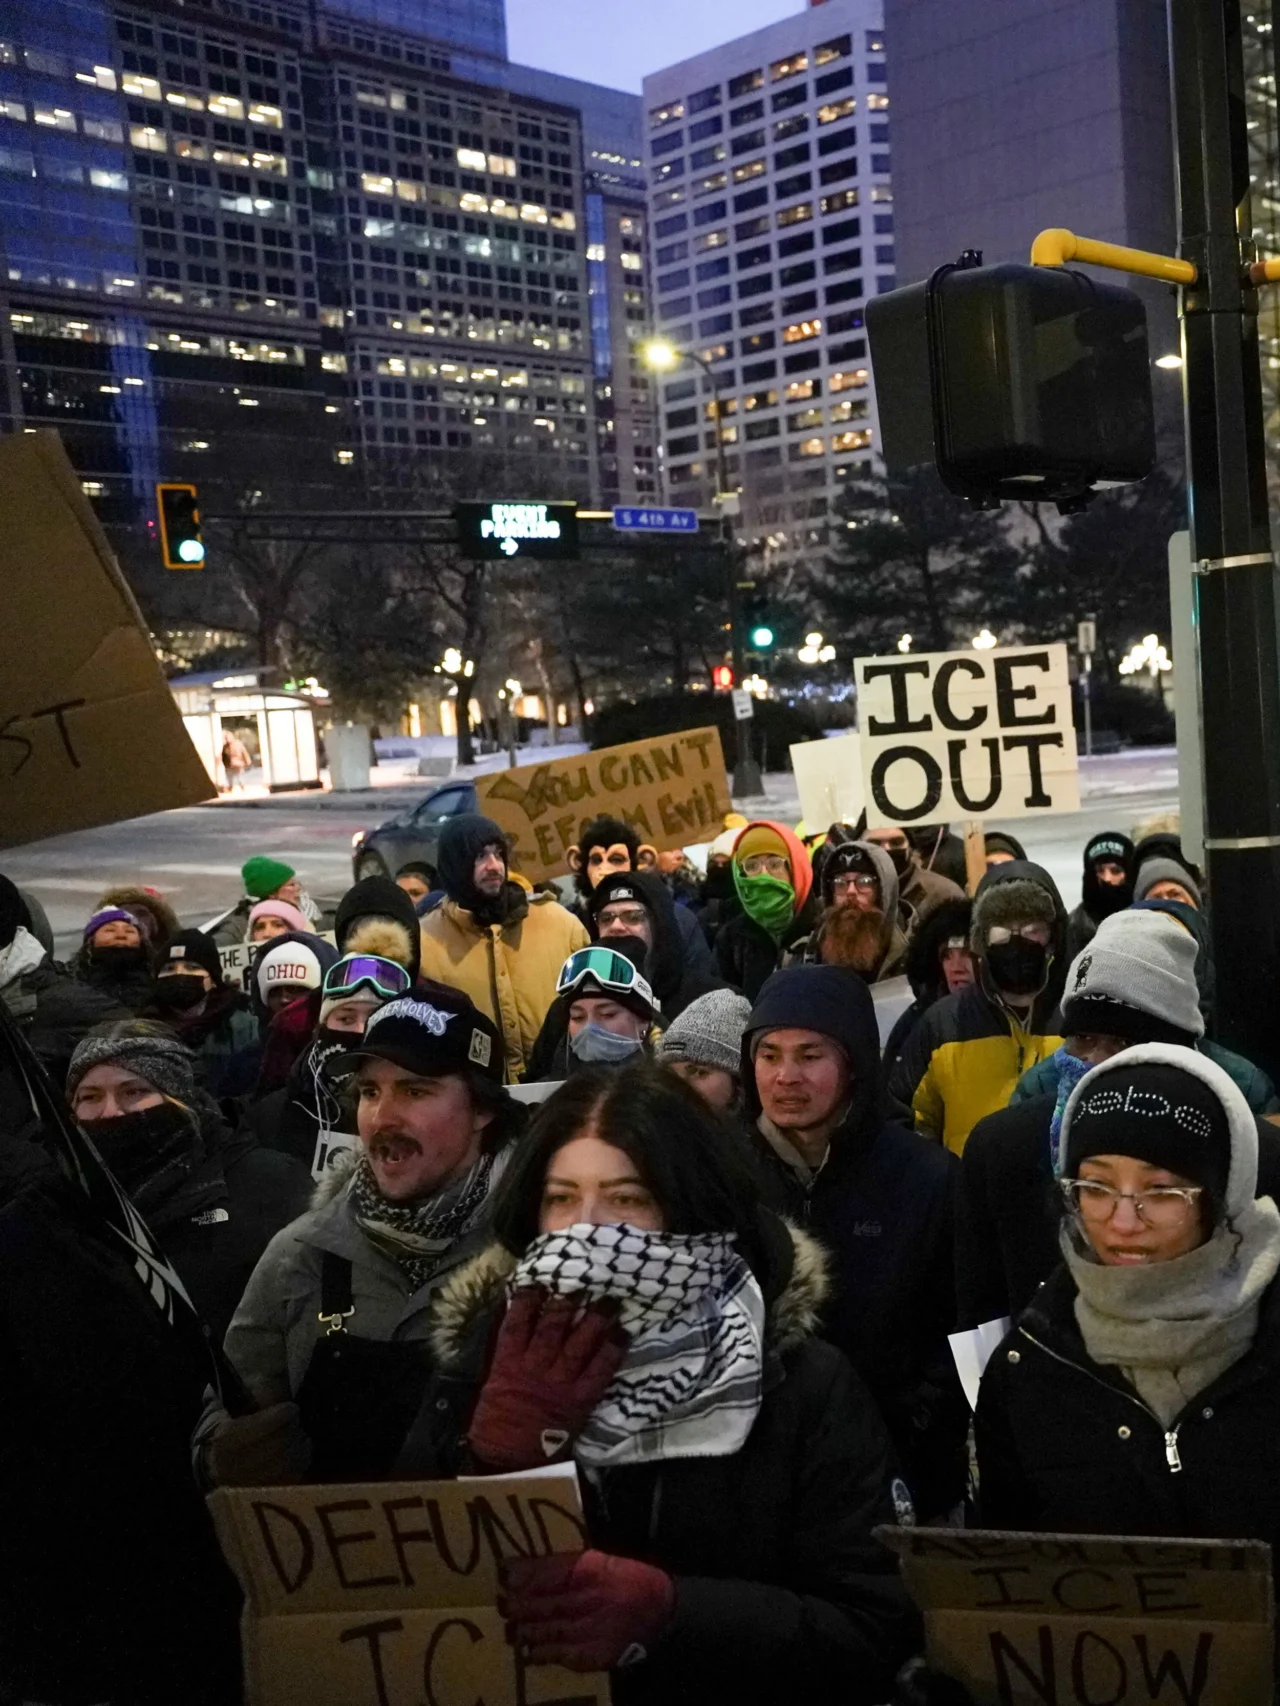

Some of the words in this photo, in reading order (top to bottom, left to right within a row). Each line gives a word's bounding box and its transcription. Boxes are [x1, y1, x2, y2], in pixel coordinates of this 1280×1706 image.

[481, 520, 560, 538] PARKING
[622, 511, 632, 525] S
[639, 513, 665, 526] 4th
[671, 514, 689, 527] Av
[863, 651, 1056, 737] ICE
[599, 732, 715, 793] CAN'T
[870, 732, 1064, 822] OUT
[266, 963, 307, 980] OHIO
[251, 1494, 591, 1594] DEFUND
[970, 1565, 1201, 1613] ICE
[988, 1624, 1214, 1706] NOW
